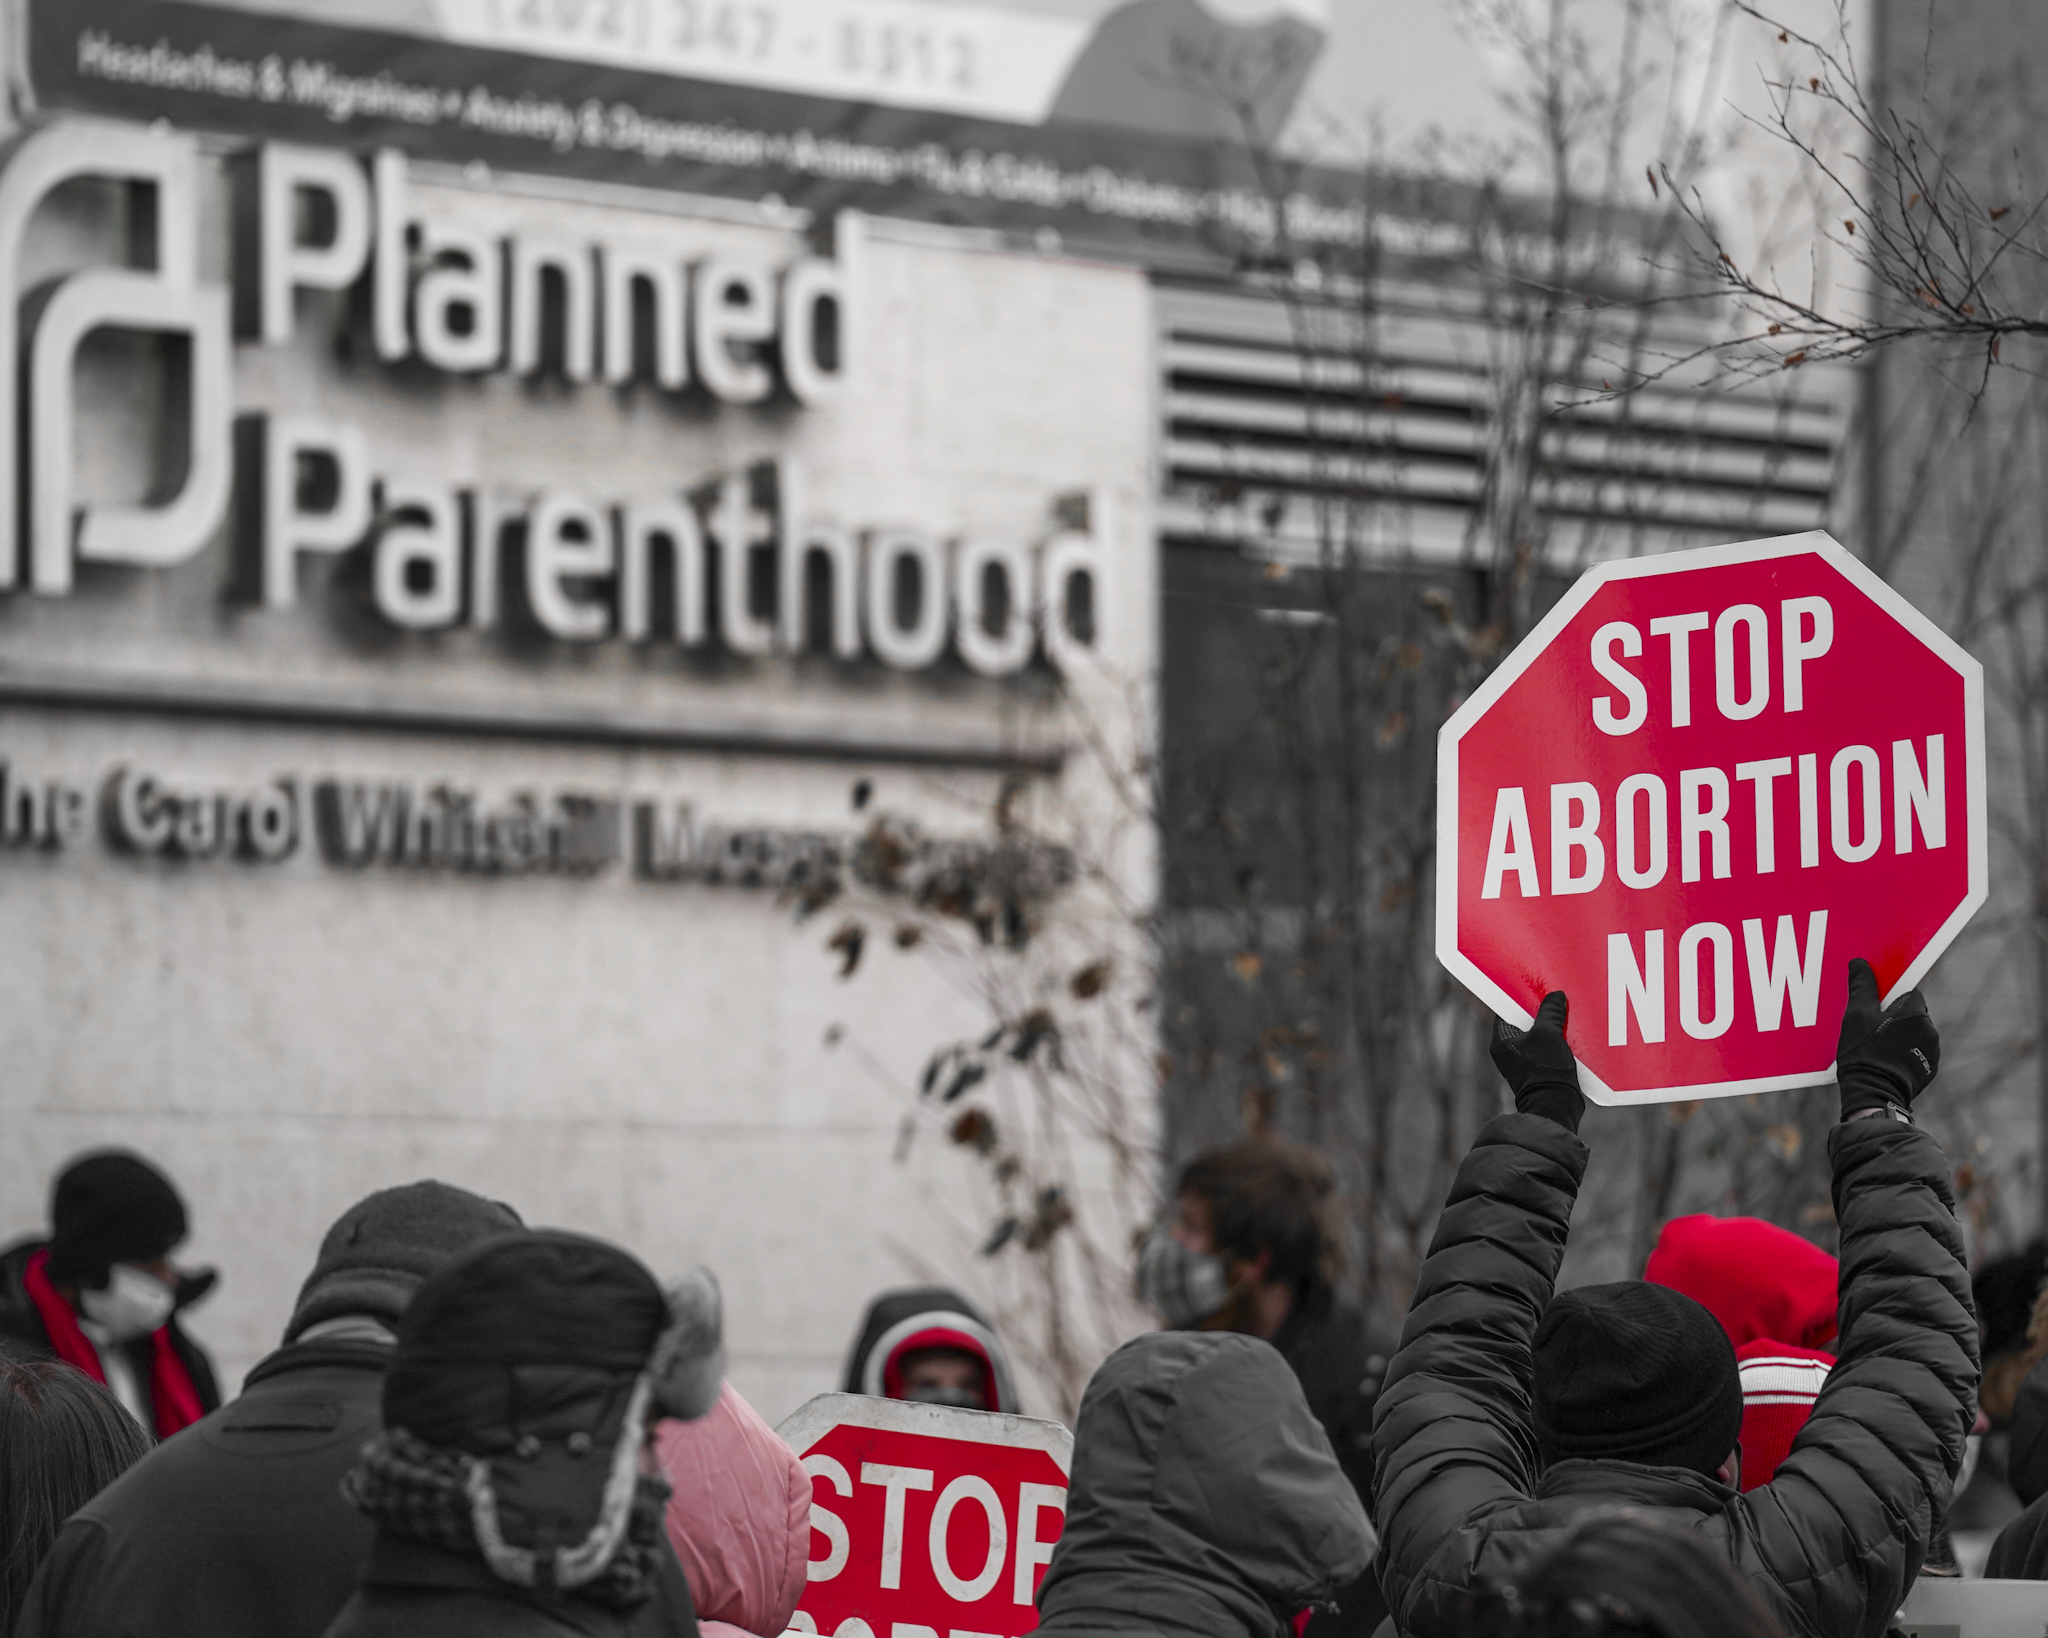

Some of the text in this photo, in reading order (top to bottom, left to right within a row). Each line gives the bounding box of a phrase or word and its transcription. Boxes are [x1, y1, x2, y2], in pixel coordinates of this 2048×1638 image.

[259, 141, 864, 401] Planned
[264, 422, 1115, 675] Parenthood
[1590, 596, 1834, 736] STOP
[1481, 733, 1947, 899] ABORTION
[1607, 909, 1829, 1047] NOW
[800, 1453, 1069, 1606] STOP
